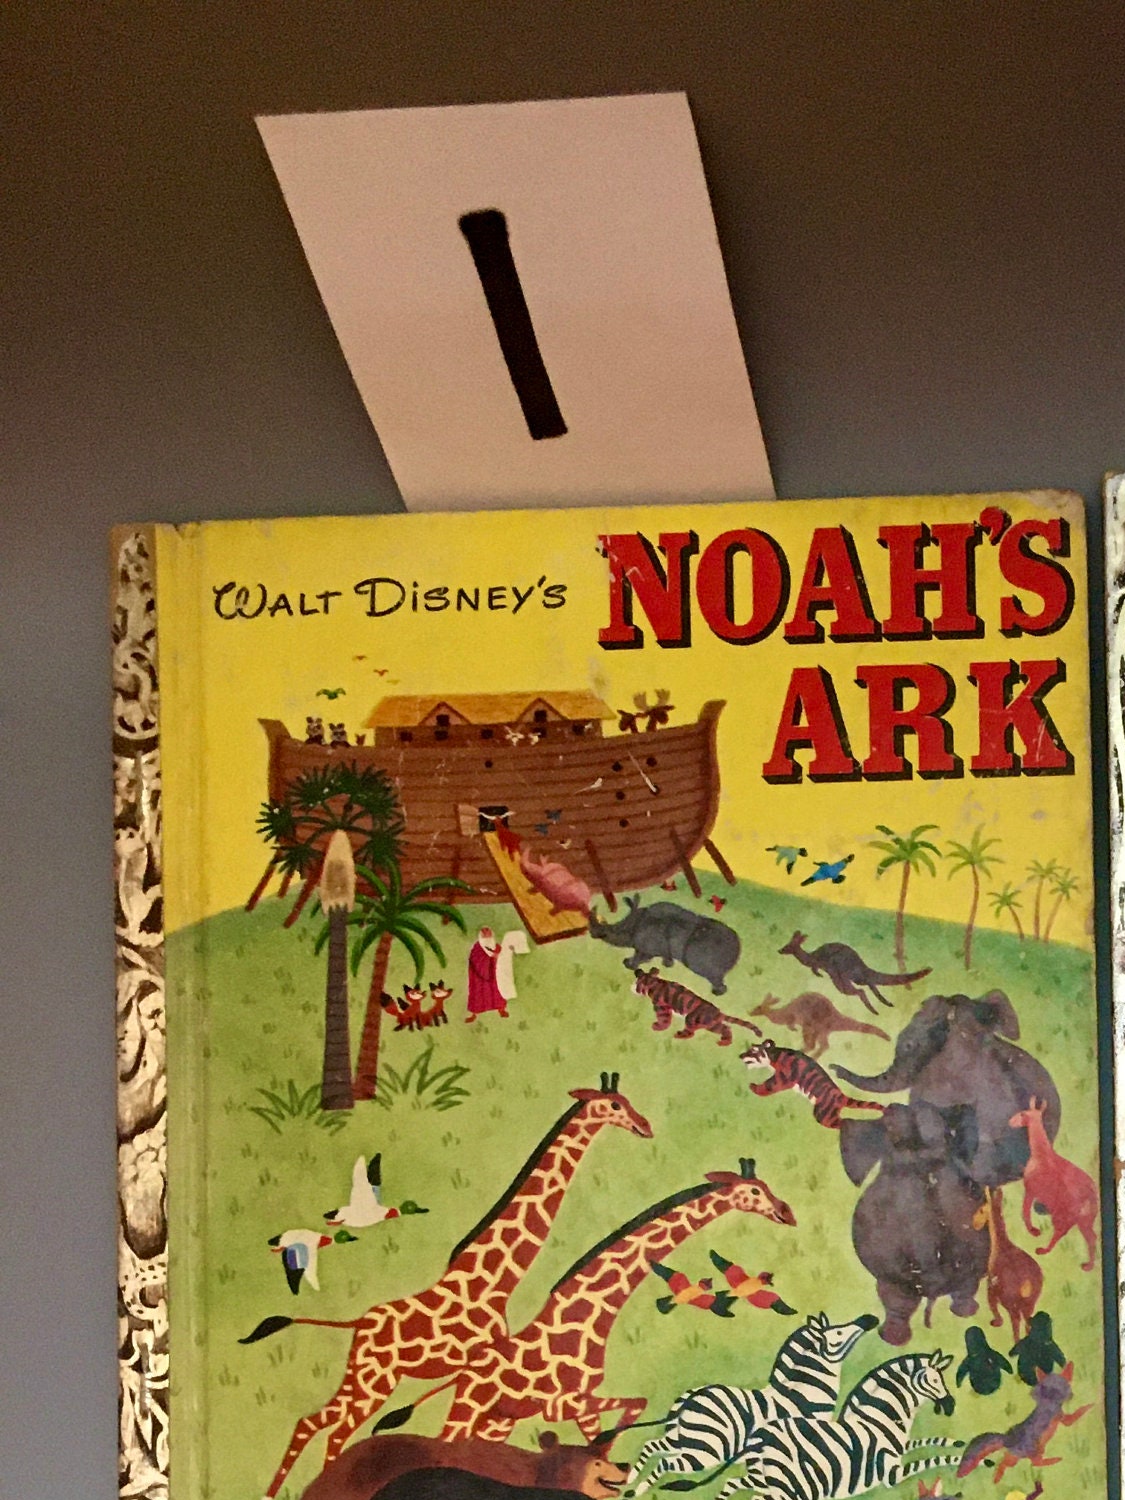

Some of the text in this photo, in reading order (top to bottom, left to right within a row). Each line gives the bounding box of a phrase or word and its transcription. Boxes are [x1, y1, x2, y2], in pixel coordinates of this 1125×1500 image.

[458, 208, 568, 441] 1
[596, 506, 1075, 650] NOAH'S
[762, 657, 1075, 785] ARK
